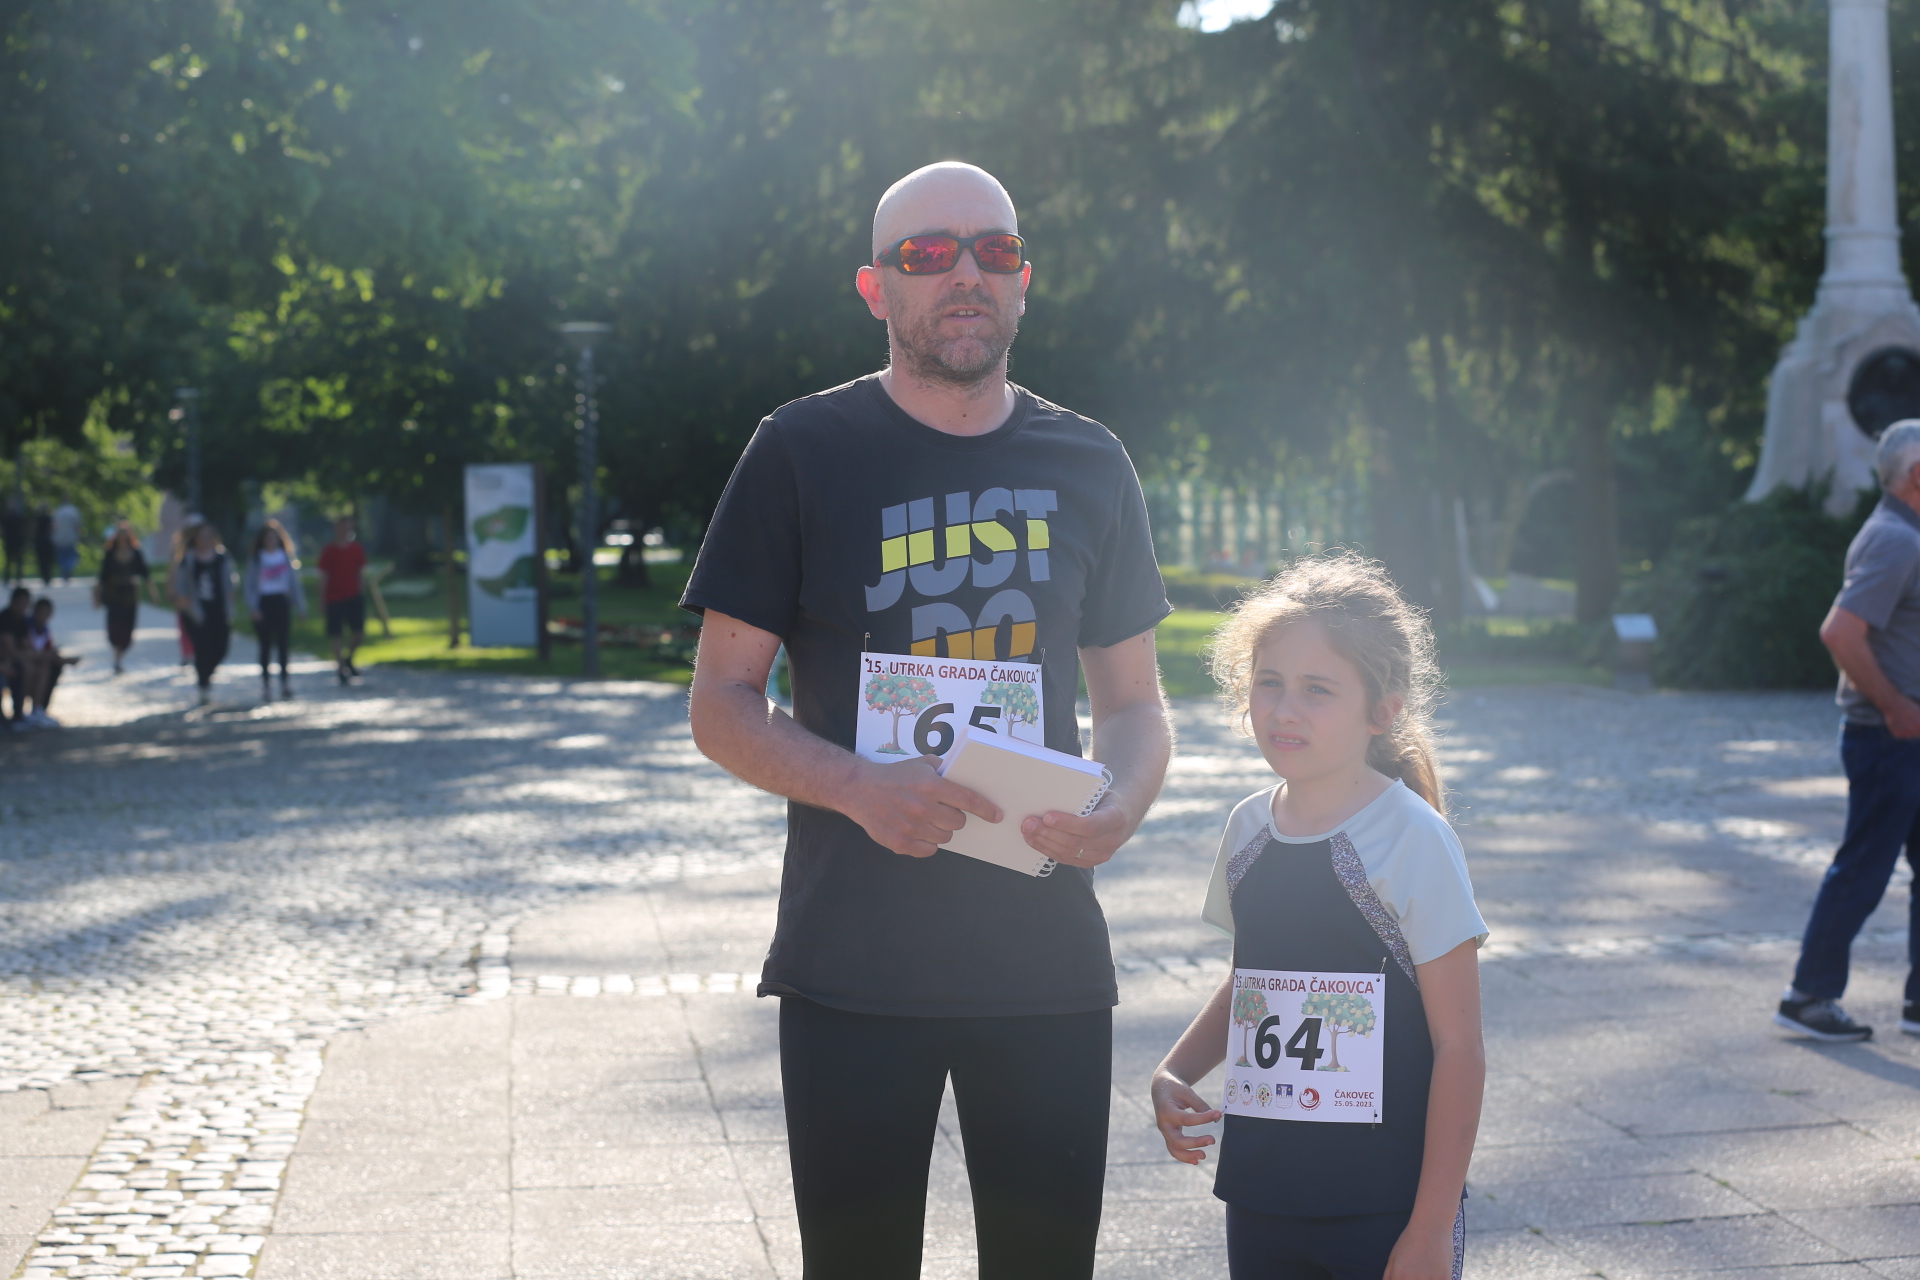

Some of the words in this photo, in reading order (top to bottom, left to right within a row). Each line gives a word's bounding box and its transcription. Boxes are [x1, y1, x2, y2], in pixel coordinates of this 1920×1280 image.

[864, 487, 1058, 612] JUST
[910, 588, 1037, 664] DO
[866, 660, 886, 674] 15.
[889, 662, 935, 678] UTRKA
[938, 665, 987, 681] GRADA
[990, 665, 1037, 684] ČAKOVCA
[1244, 976, 1267, 991] UTRKA
[1268, 977, 1307, 992] GRADA
[1309, 976, 1375, 994] ČAKOVCA
[1254, 1014, 1325, 1071] 64
[1333, 1100, 1375, 1108] 25.05.2023.
[1334, 1088, 1375, 1100] ČAKOVEC
